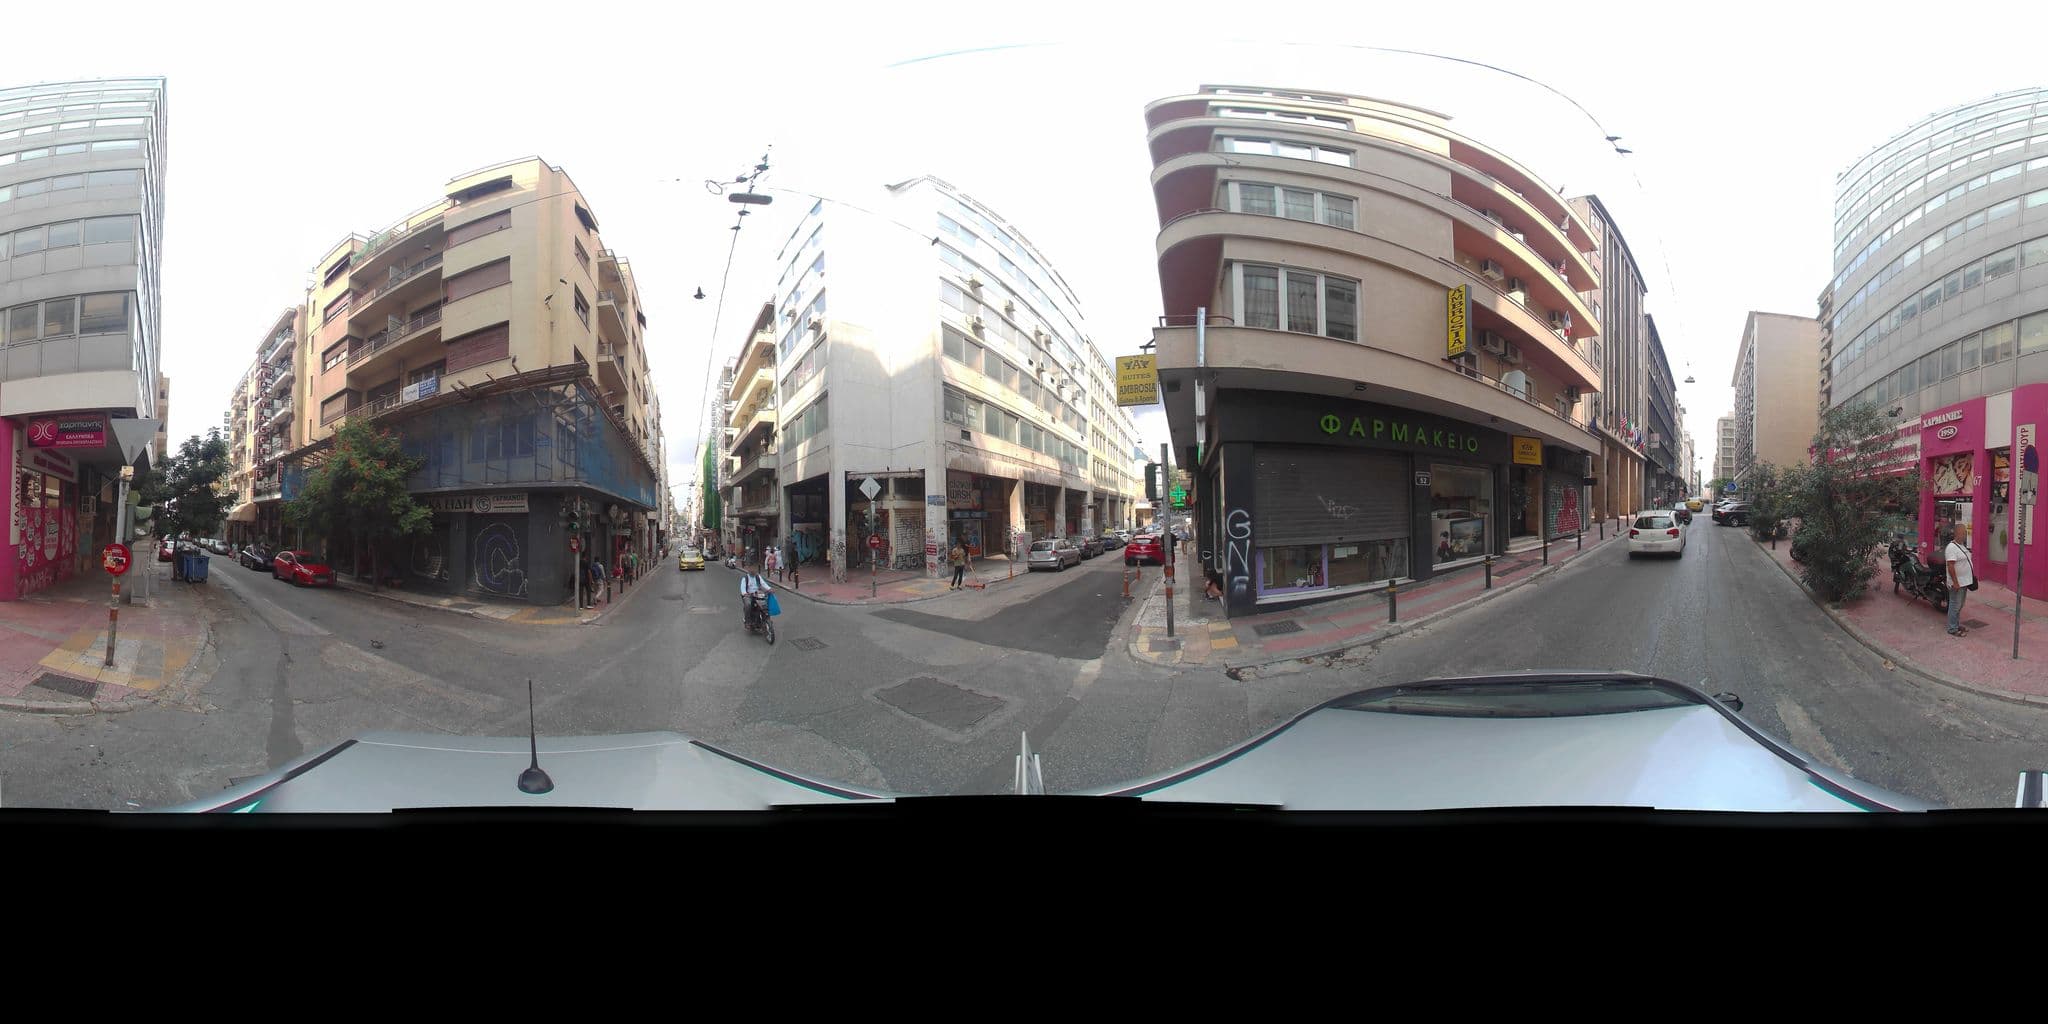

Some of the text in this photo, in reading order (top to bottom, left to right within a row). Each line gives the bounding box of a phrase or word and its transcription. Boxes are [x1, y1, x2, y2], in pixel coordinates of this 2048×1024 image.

[1451, 288, 1464, 348] AMBROSIA
[1120, 383, 1157, 394] AMBROSIA
[1321, 414, 1478, 452] ΦΑΡΜΑΚΕΙΟ
[1973, 476, 1982, 486] 67
